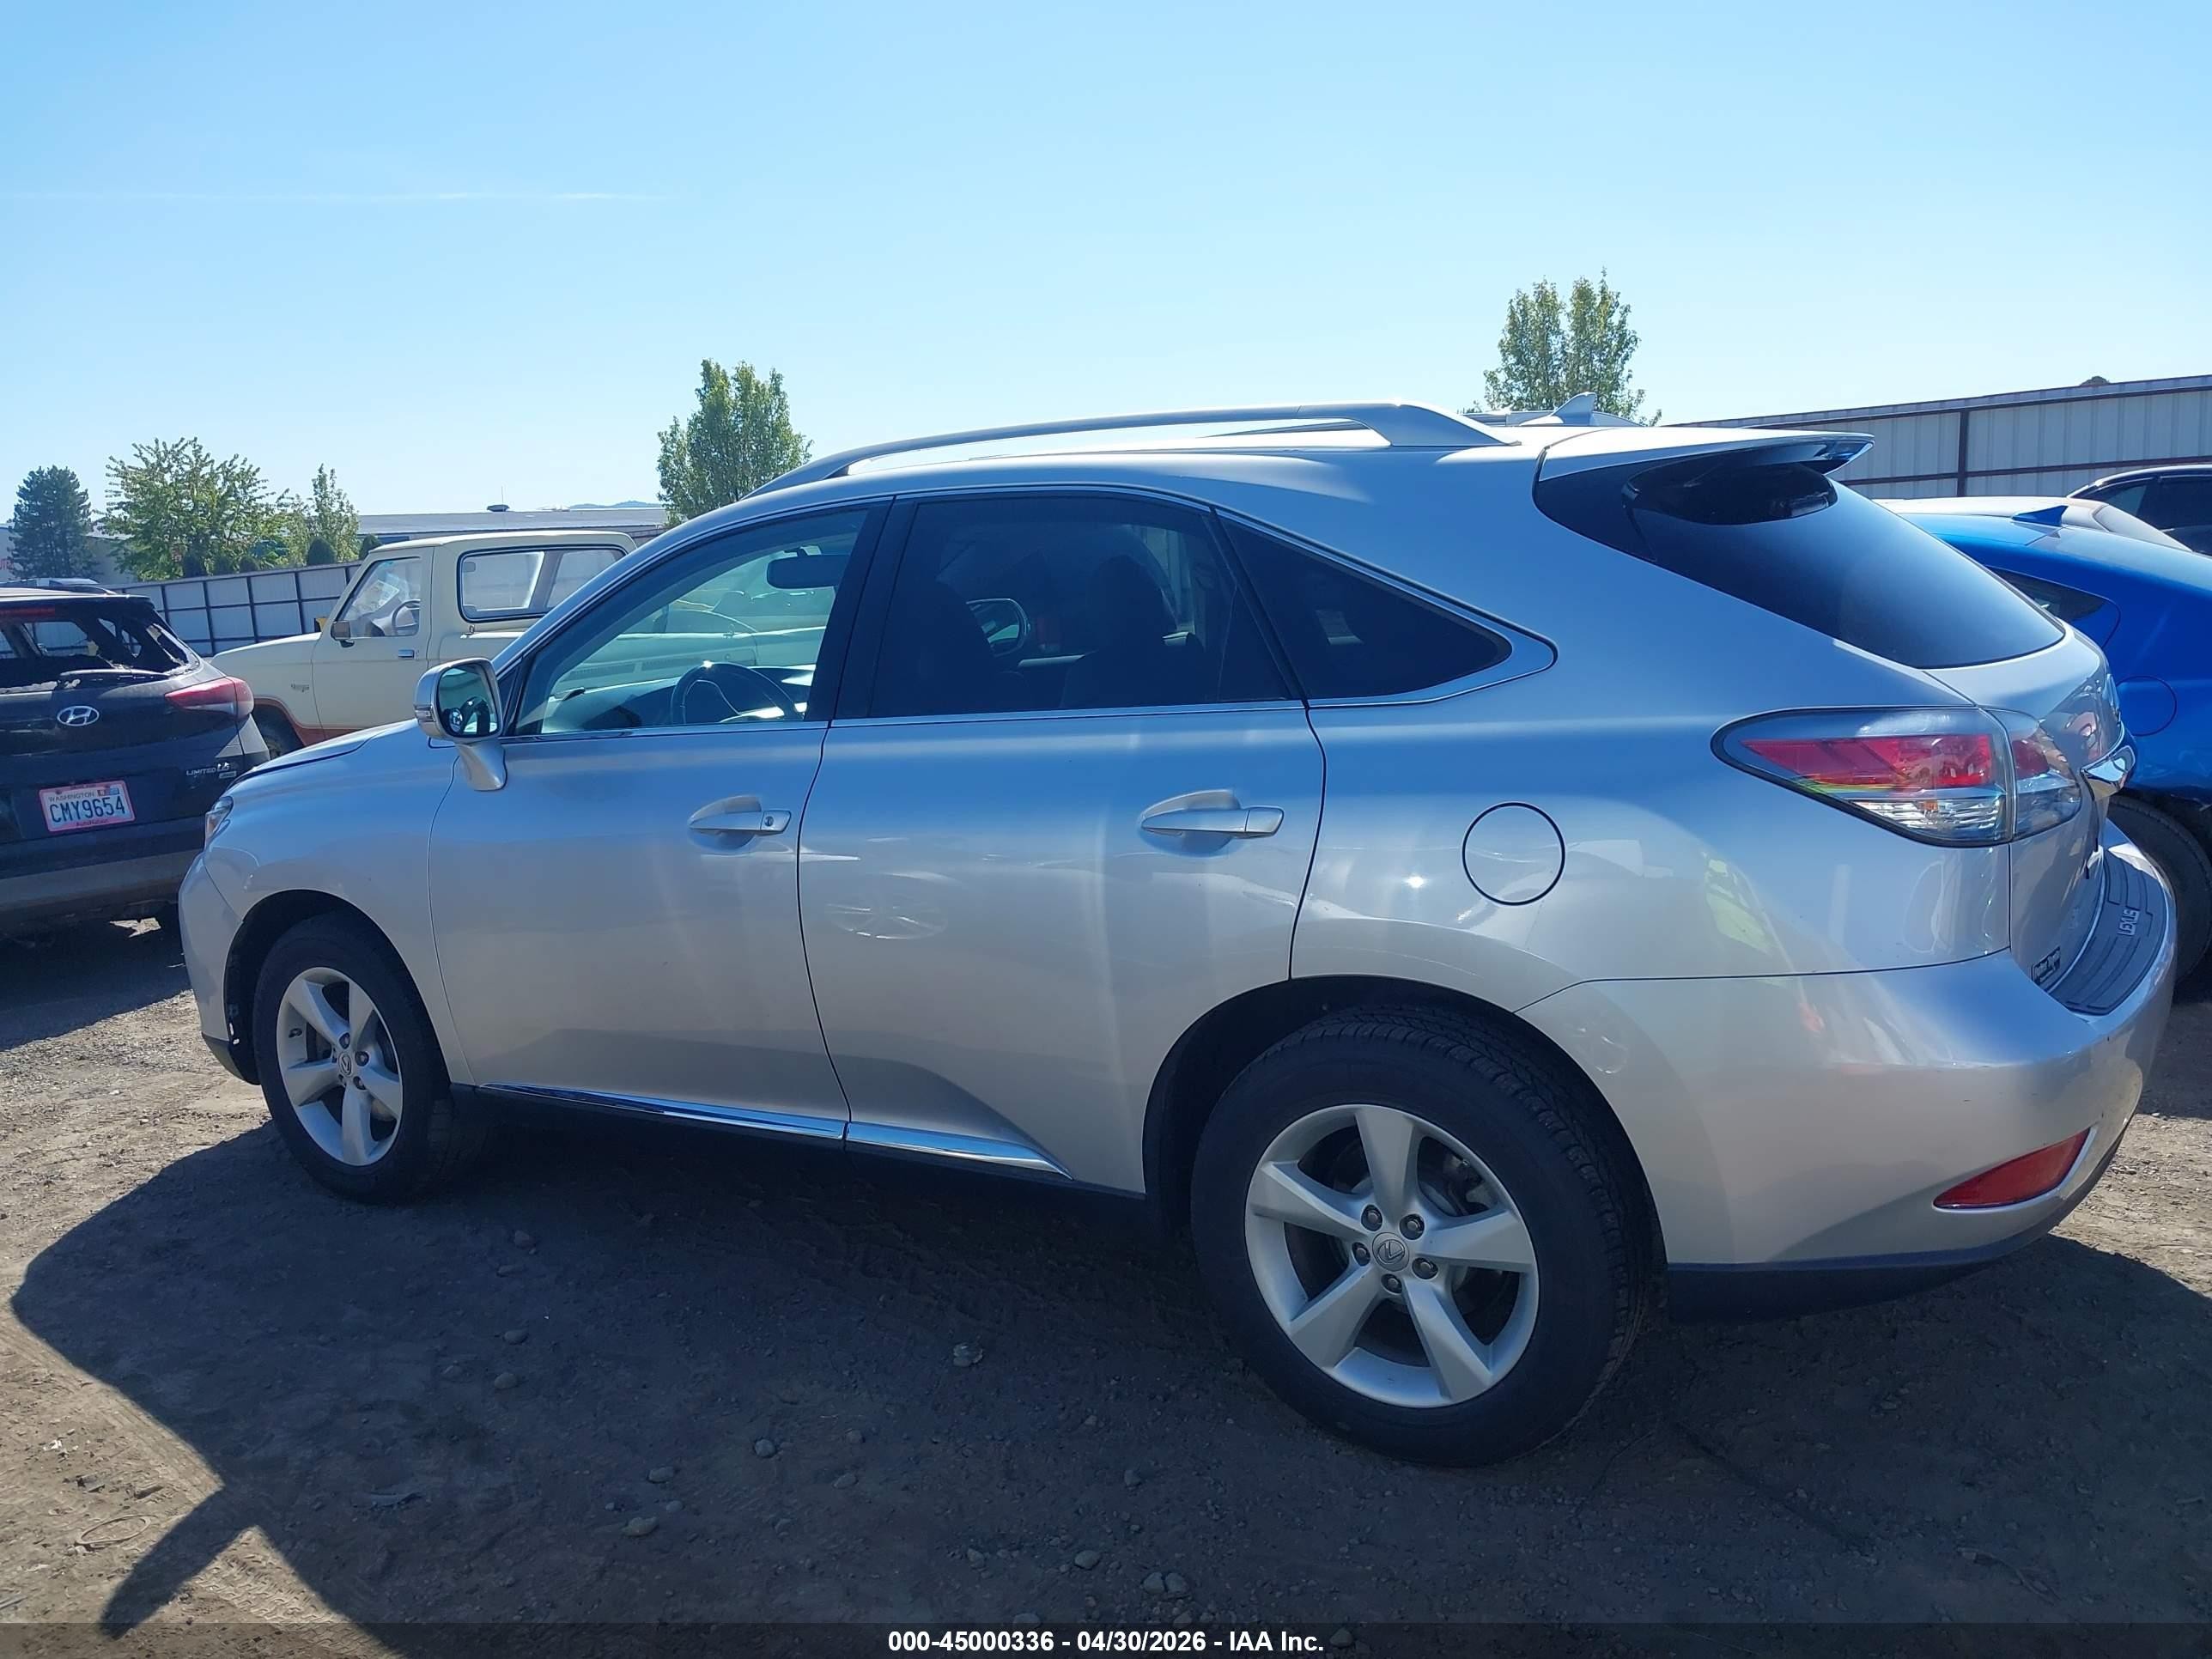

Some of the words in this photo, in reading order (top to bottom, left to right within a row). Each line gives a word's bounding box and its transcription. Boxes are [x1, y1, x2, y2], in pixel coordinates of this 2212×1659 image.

[185, 767, 216, 776] LIMITED
[48, 791, 95, 802] WASHINGTON
[50, 795, 125, 823] CMY9654
[2117, 909, 2140, 936] LEXUS
